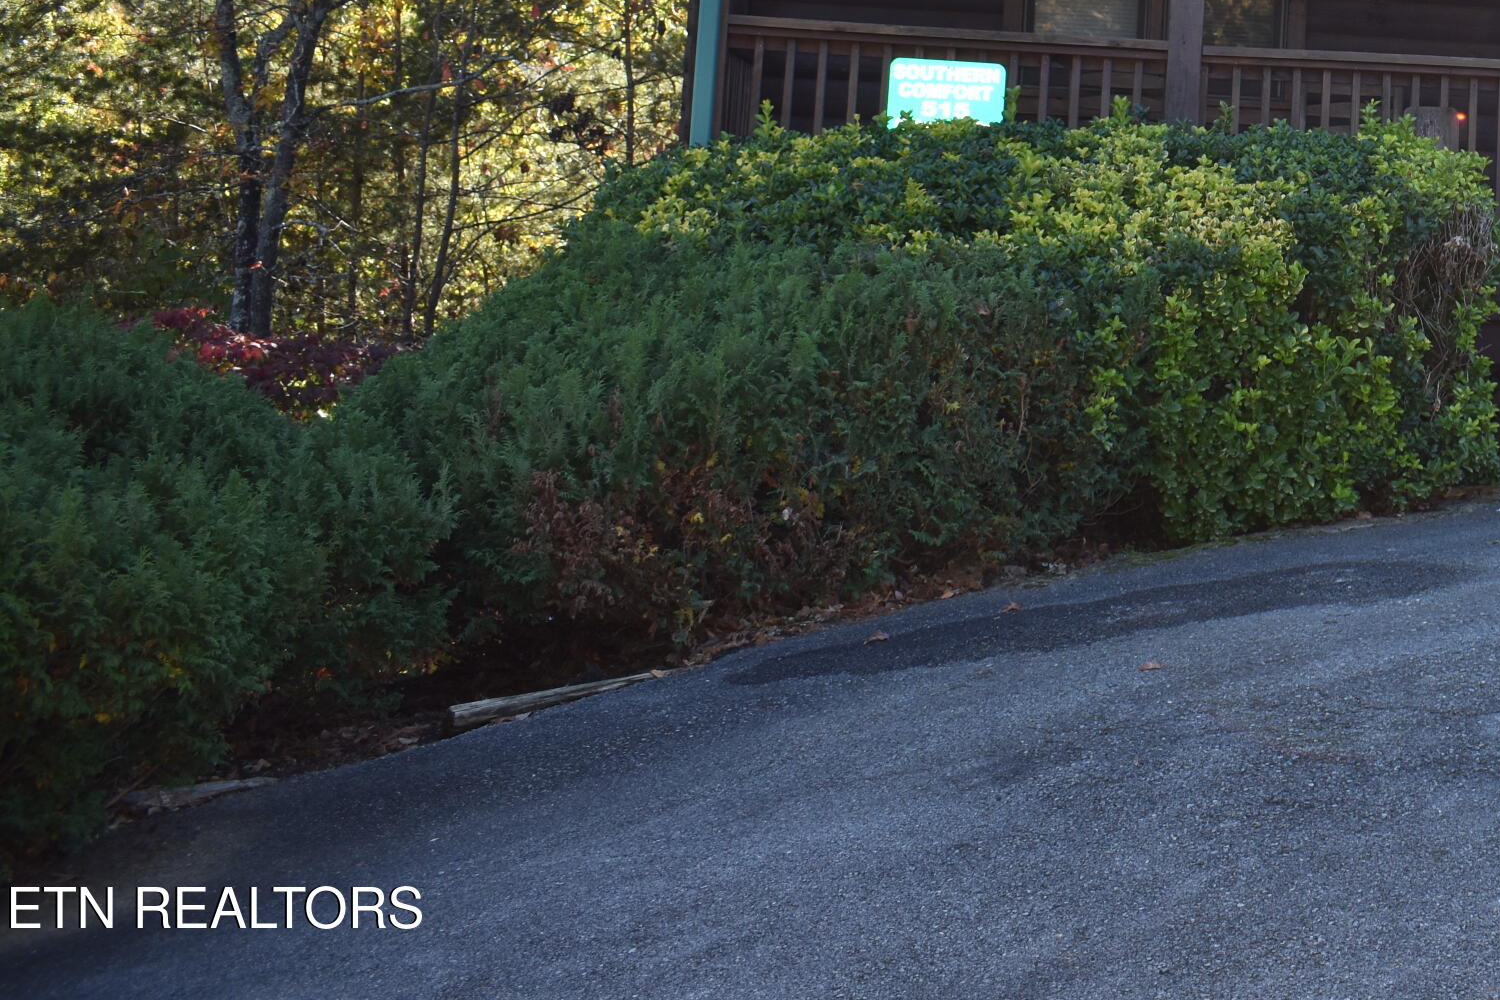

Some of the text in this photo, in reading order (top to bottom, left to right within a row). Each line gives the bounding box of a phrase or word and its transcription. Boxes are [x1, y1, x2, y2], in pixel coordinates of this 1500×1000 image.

[893, 63, 1001, 84] SOUTHERN
[898, 81, 995, 101] COMFORT
[920, 100, 972, 119] 515
